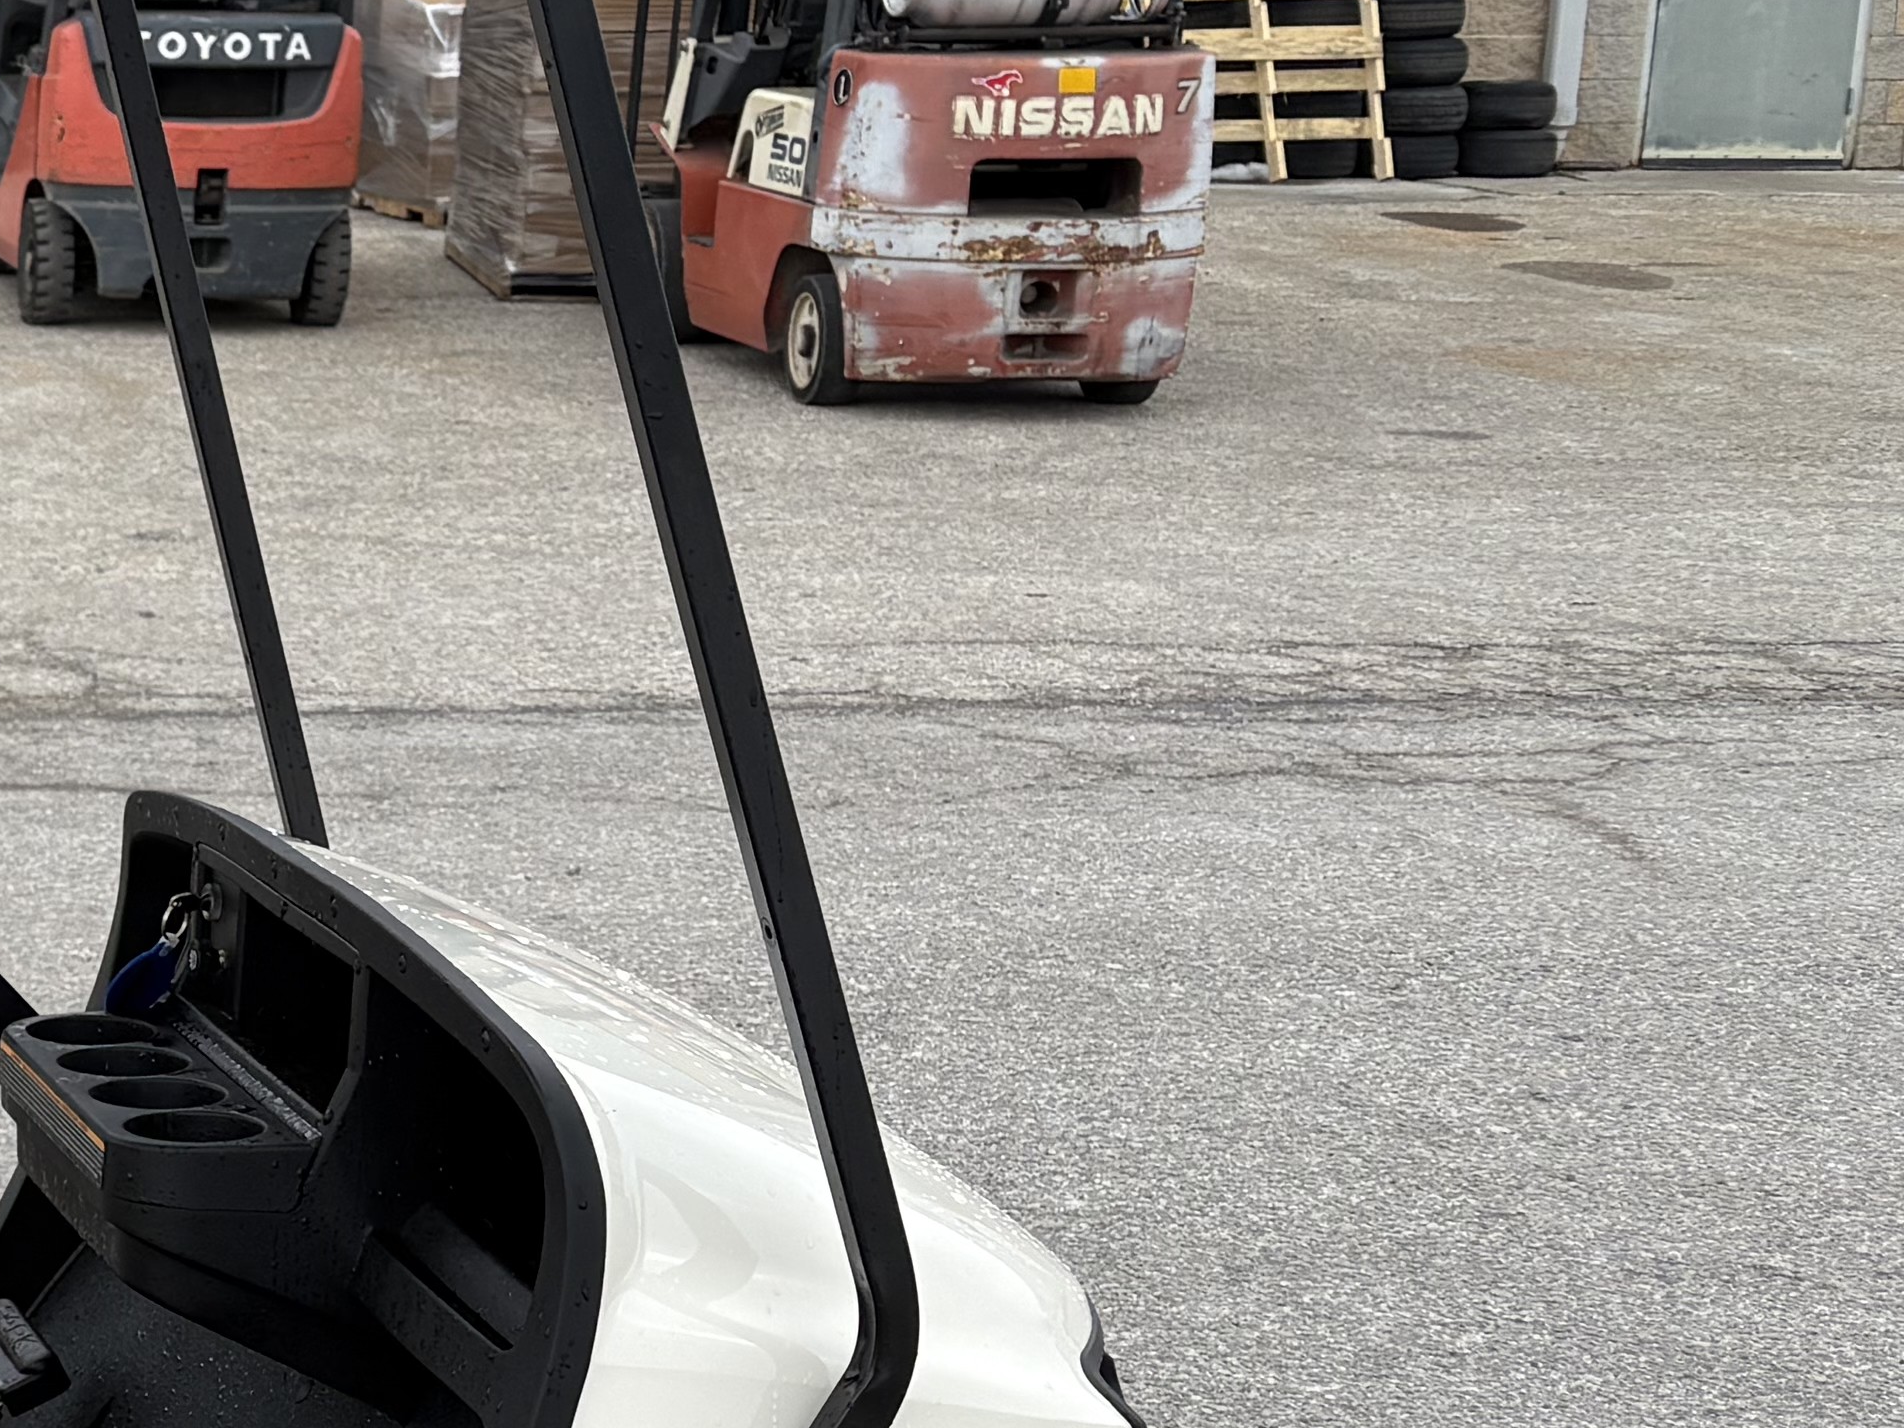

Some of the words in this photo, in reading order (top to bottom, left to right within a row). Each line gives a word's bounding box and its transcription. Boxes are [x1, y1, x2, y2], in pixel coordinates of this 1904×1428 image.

[141, 31, 312, 61] OYOTA
[1176, 78, 1201, 115] 7
[953, 94, 1164, 139] NISSAN
[771, 133, 806, 165] 50
[767, 163, 803, 188] NISSAN
